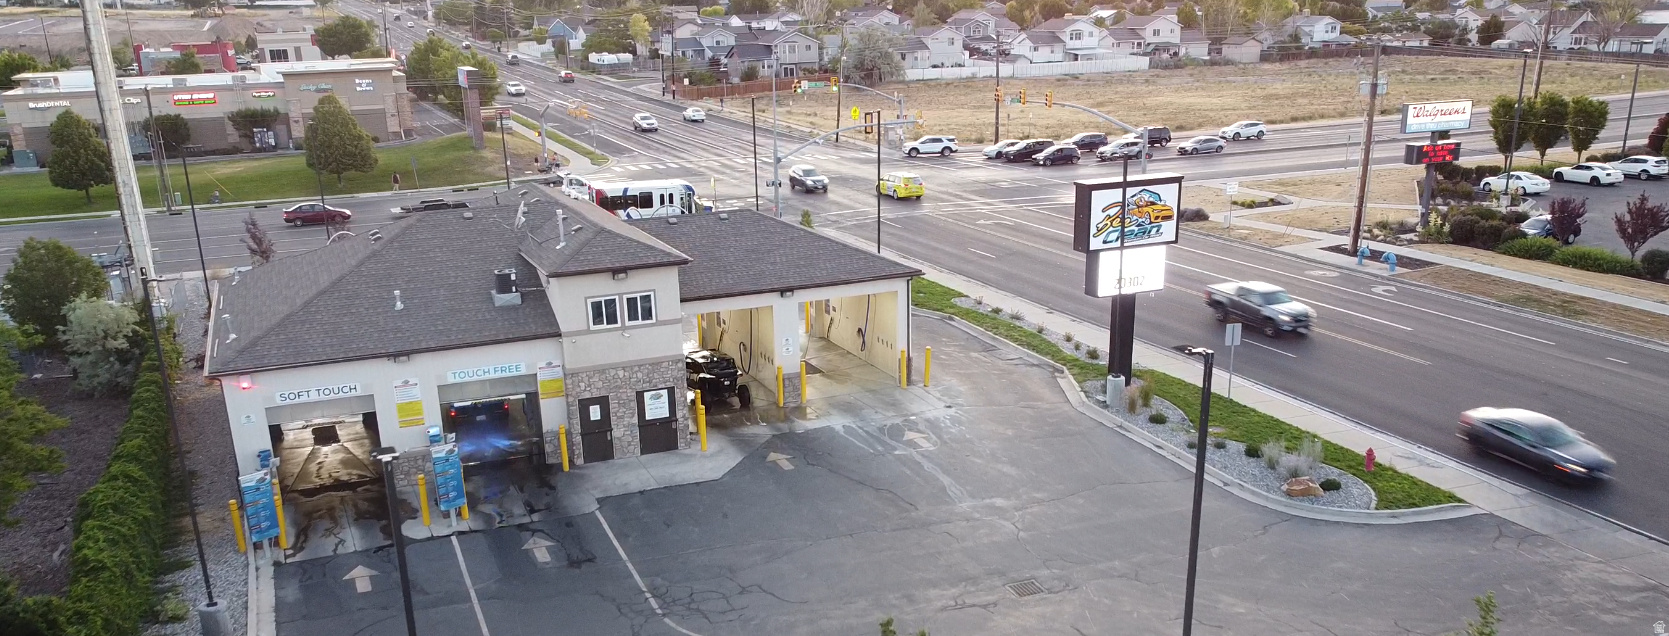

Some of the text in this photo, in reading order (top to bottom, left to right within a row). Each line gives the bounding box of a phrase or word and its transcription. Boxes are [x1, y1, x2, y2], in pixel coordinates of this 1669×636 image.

[1412, 105, 1467, 121] Walgreens
[1093, 202, 1138, 238] Bee
[1102, 224, 1163, 245] Clean
[452, 364, 522, 380] TOUCH FREE
[280, 384, 358, 402] SOFT TOUCH
